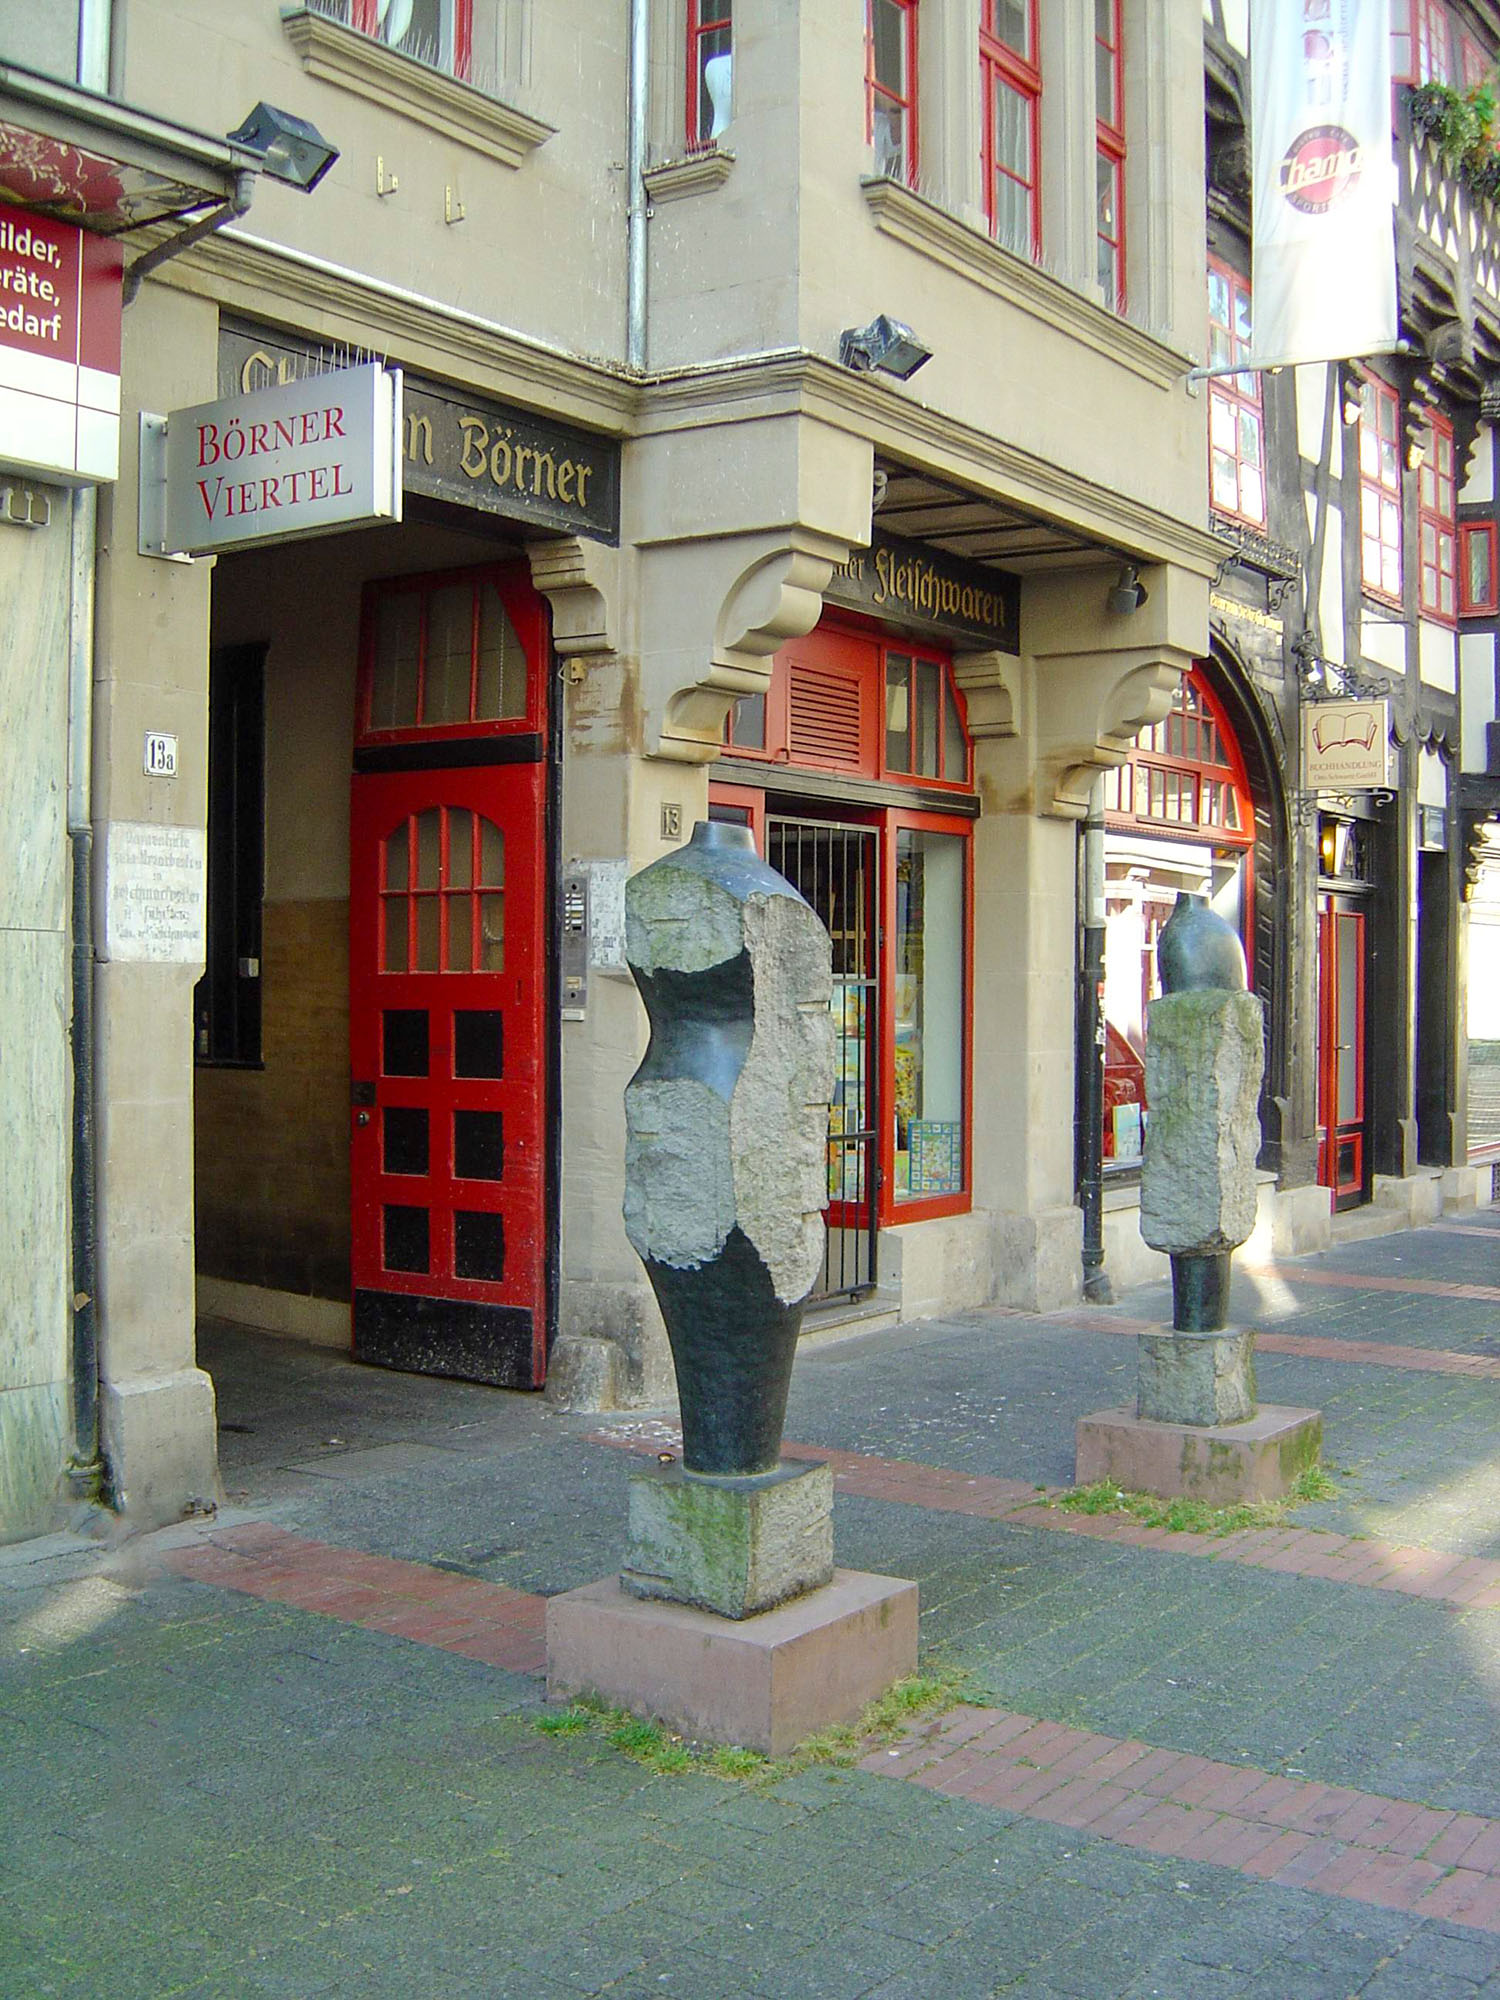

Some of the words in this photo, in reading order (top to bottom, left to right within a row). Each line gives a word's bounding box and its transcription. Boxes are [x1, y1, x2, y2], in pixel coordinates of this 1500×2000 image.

[196, 407, 347, 468] BÖRNER
[457, 415, 593, 508] Börner
[196, 464, 353, 520] VIERTEL
[150, 739, 174, 771] 13a
[663, 807, 680, 837] 13
